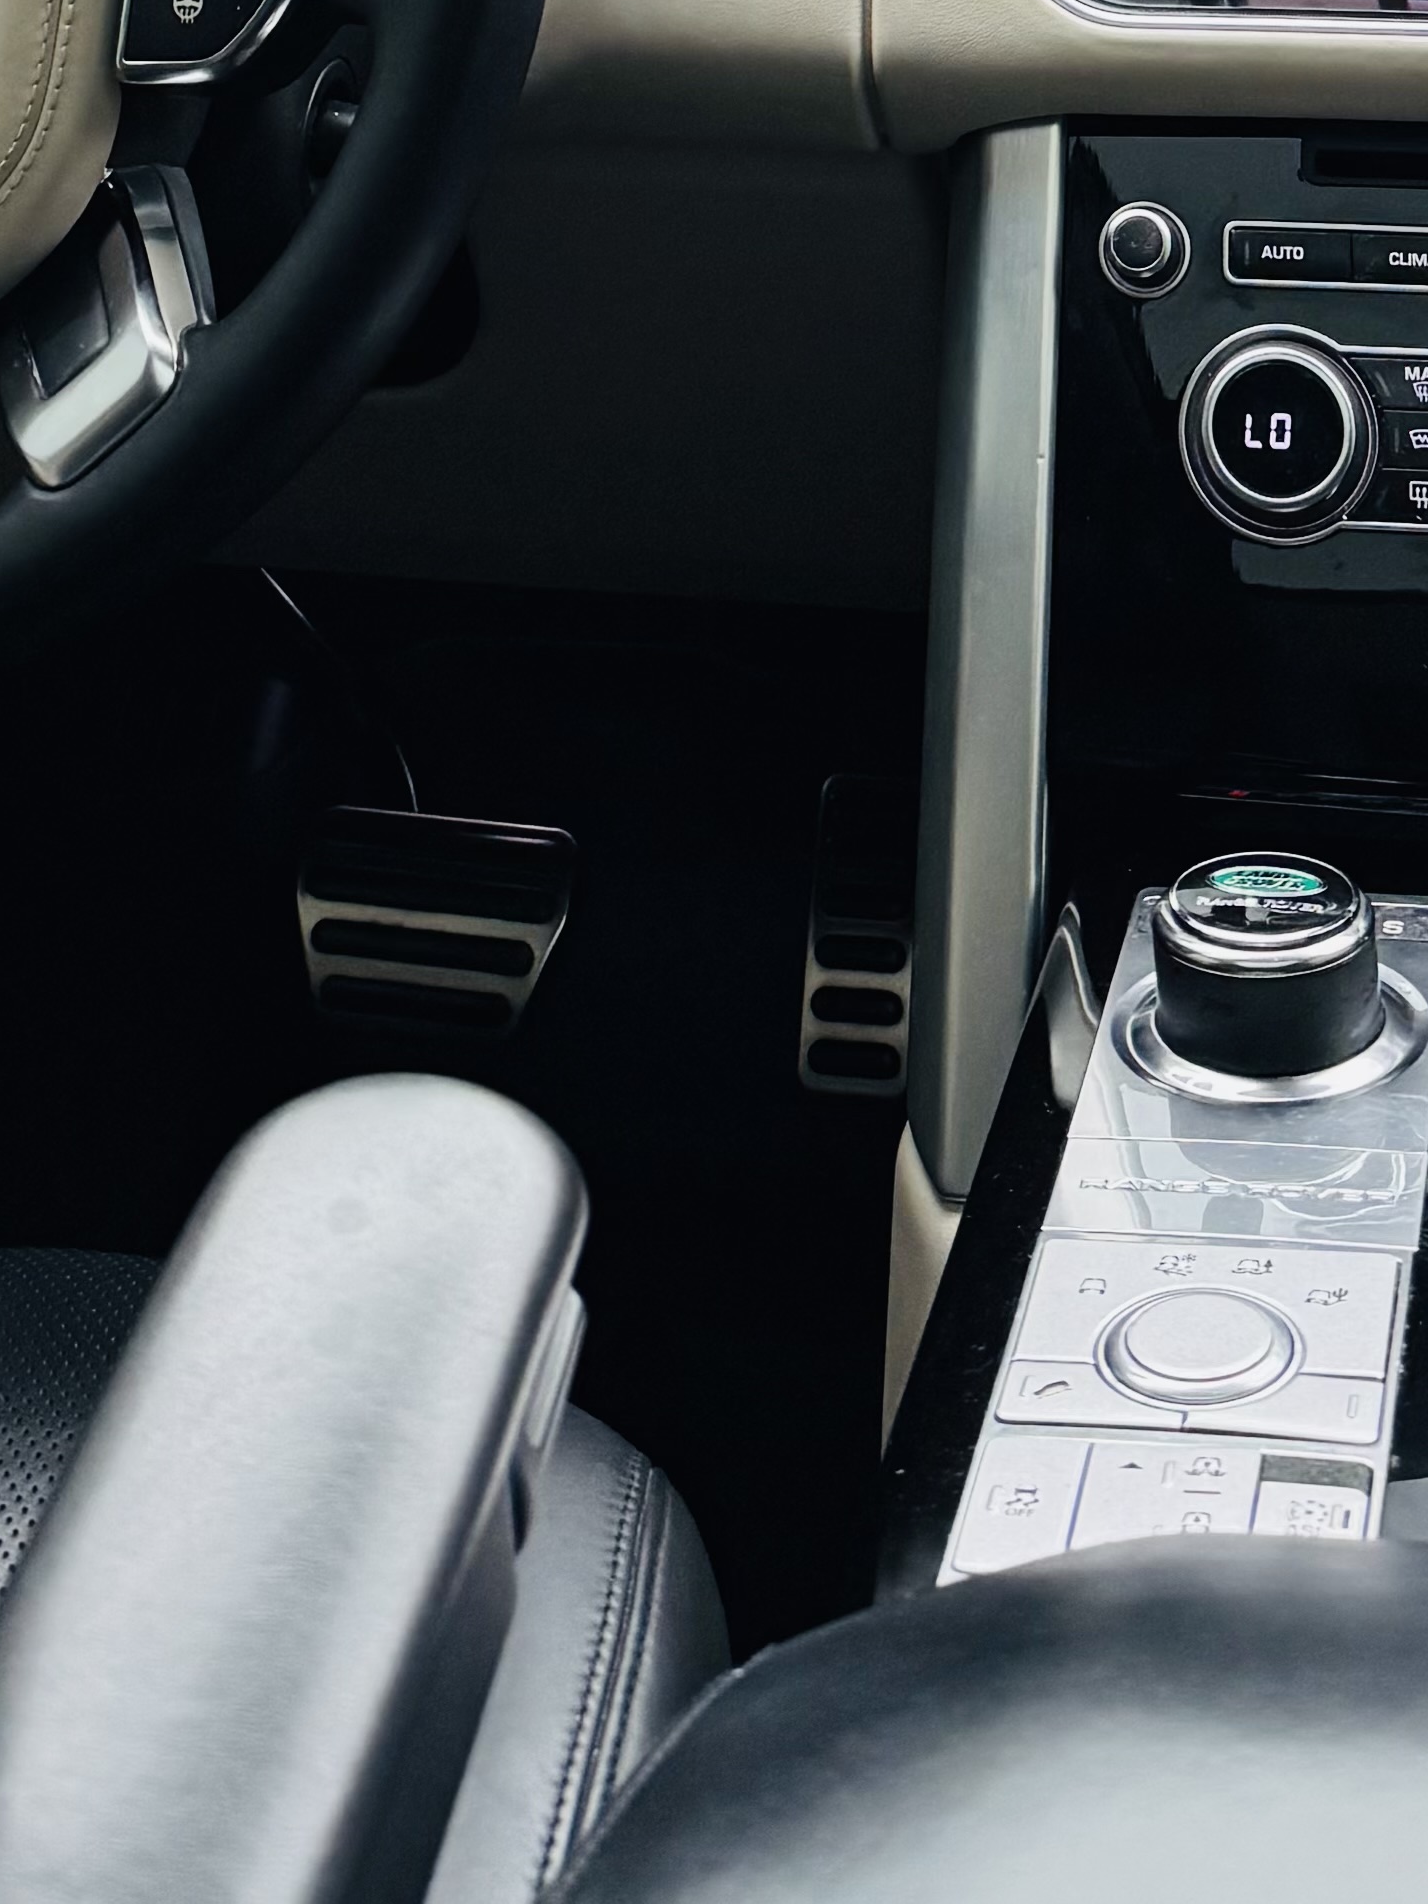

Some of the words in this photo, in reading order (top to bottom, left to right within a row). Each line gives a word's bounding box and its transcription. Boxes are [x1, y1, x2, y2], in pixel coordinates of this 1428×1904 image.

[1261, 245, 1305, 261] AUTO
[1244, 412, 1292, 450] LO
[1382, 919, 1405, 935] S
[1079, 1177, 1229, 1193] RANGE
[1005, 1507, 1035, 1518] OFF
